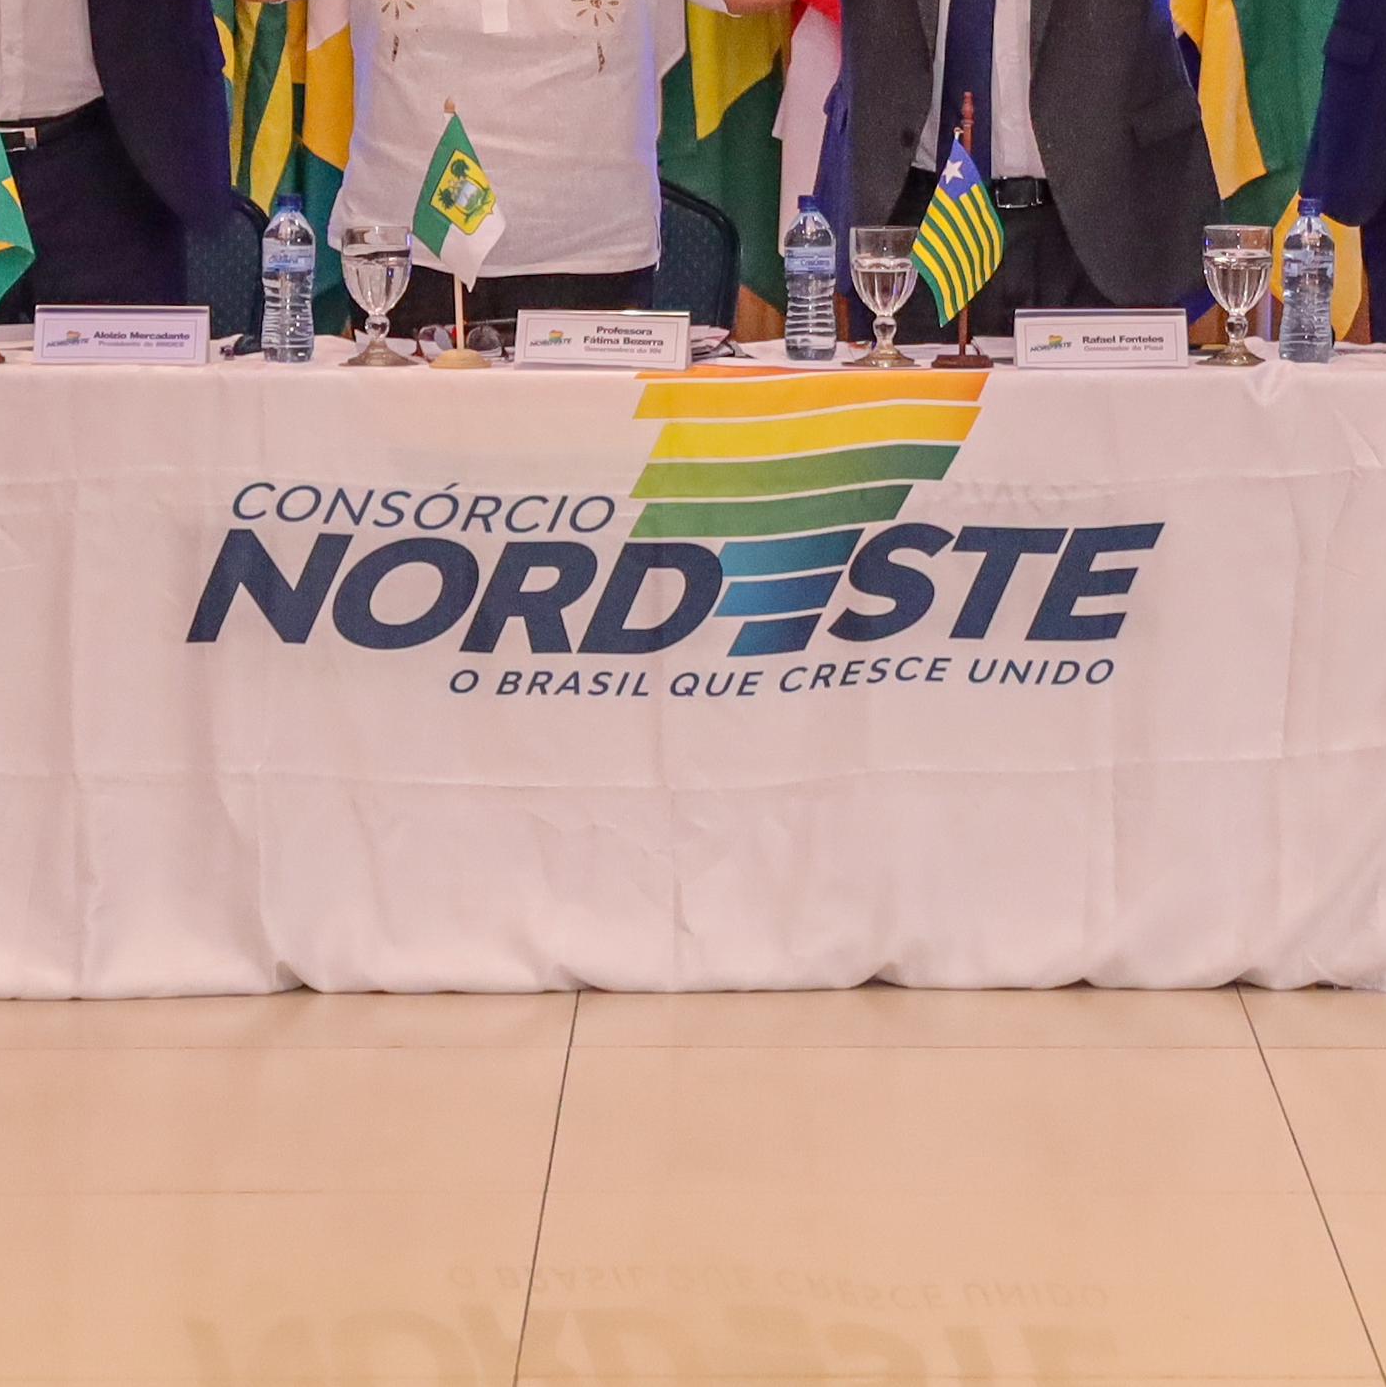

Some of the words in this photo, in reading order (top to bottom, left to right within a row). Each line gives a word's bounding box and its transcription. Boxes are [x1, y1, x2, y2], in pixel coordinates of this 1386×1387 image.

[129, 331, 191, 340] Mercadante
[596, 325, 653, 336] Professora
[583, 335, 620, 345] Fátima
[623, 337, 664, 347] Bezerra
[1082, 335, 1116, 344] Rafael
[1119, 334, 1164, 343] Fonteles
[231, 481, 615, 534] CONSÓRCIO
[185, 521, 1165, 657] NORDESTE
[448, 669, 479, 694] O
[495, 670, 650, 696] BRASIL
[669, 671, 764, 697] QUE
[778, 656, 952, 693] CRESCE
[967, 658, 1115, 685] UNIDO
